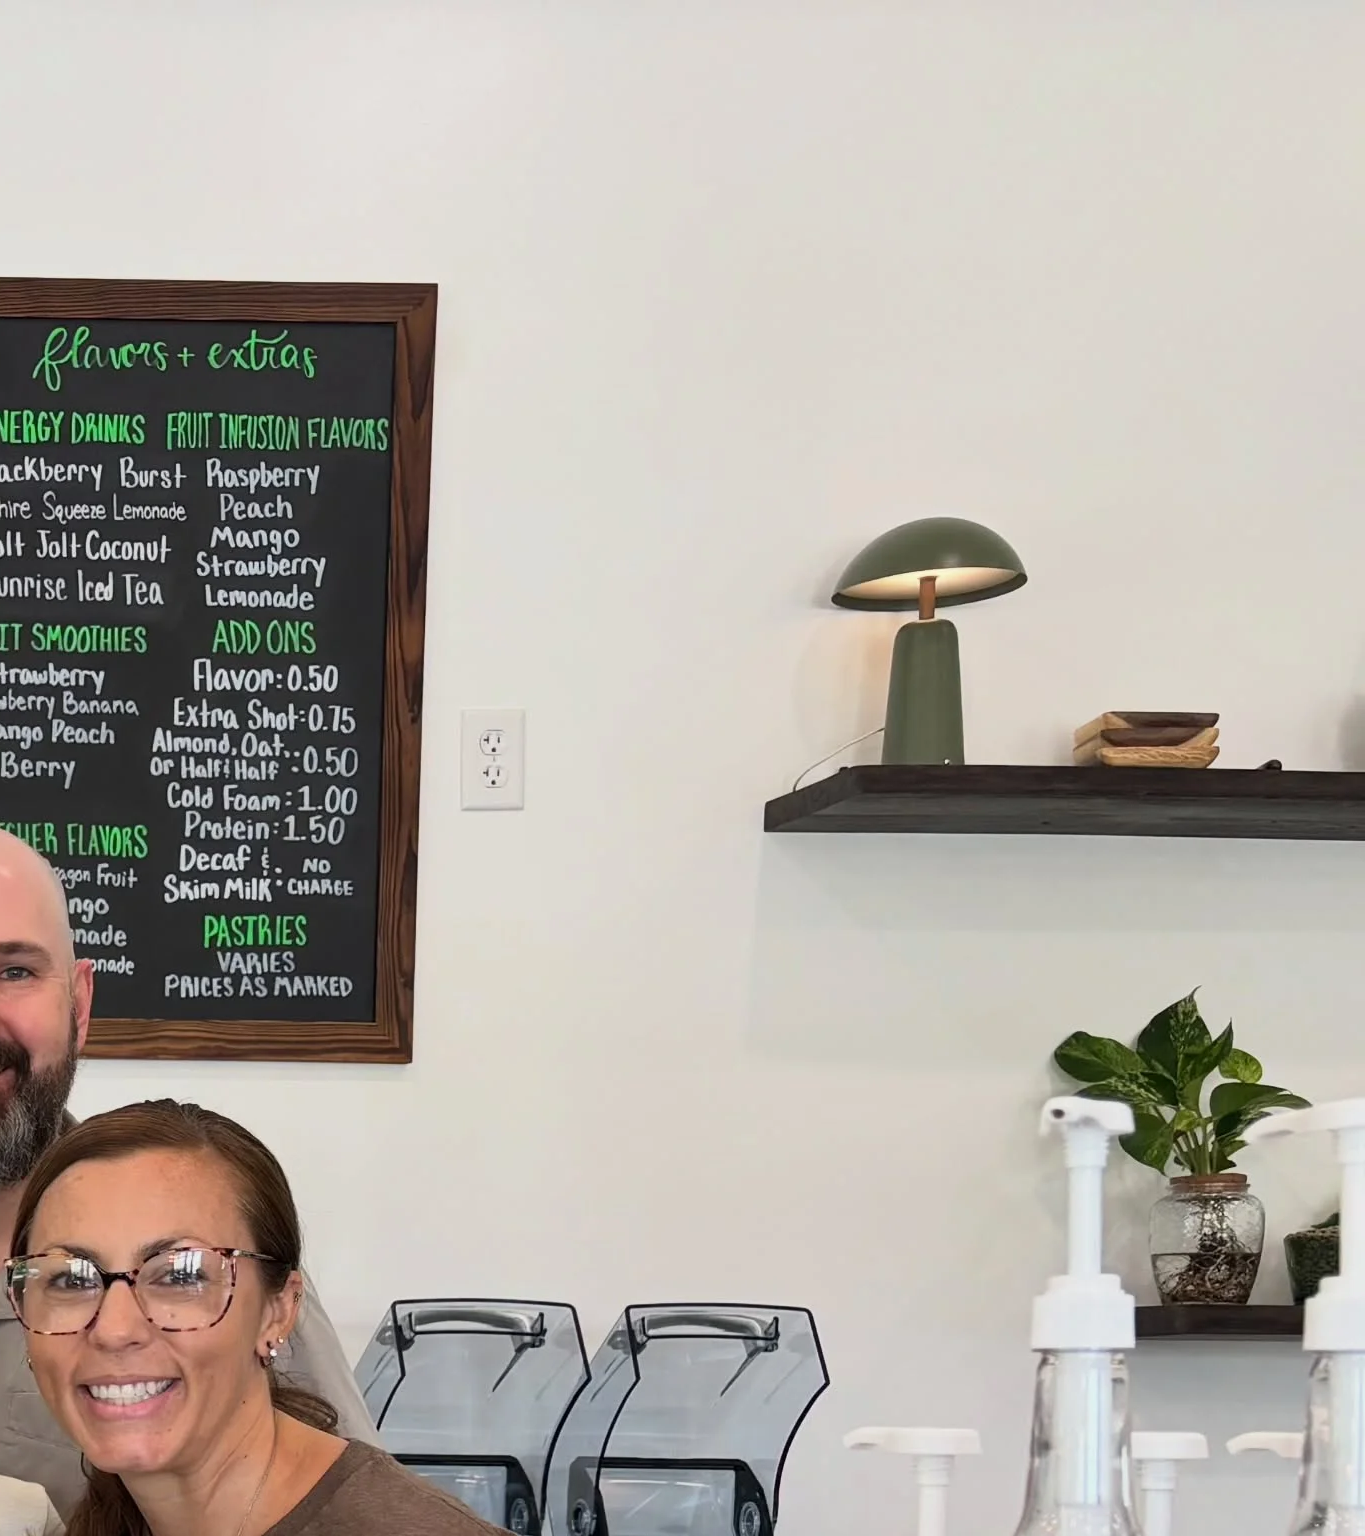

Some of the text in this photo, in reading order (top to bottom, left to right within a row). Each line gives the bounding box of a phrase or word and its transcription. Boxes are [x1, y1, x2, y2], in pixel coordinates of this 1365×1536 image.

[32, 326, 169, 392] flavors
[207, 329, 318, 379] extras
[71, 411, 146, 445] DRINKS
[166, 411, 389, 451] FRUIT INFUSION FLAVORS
[42, 490, 107, 525] Squeeze
[113, 493, 188, 522] Lemonade
[30, 622, 148, 654] SMOOTHIES
[212, 619, 317, 655] ADD ONS
[66, 823, 148, 859] FLAVORS
[53, 862, 138, 890] ragon Fruit
[302, 857, 332, 874] NO
[287, 877, 354, 897] CHARGE
[203, 914, 307, 949] PASTRIES
[216, 950, 296, 975] VARIES
[164, 973, 353, 999] PRICES AS MARKED
